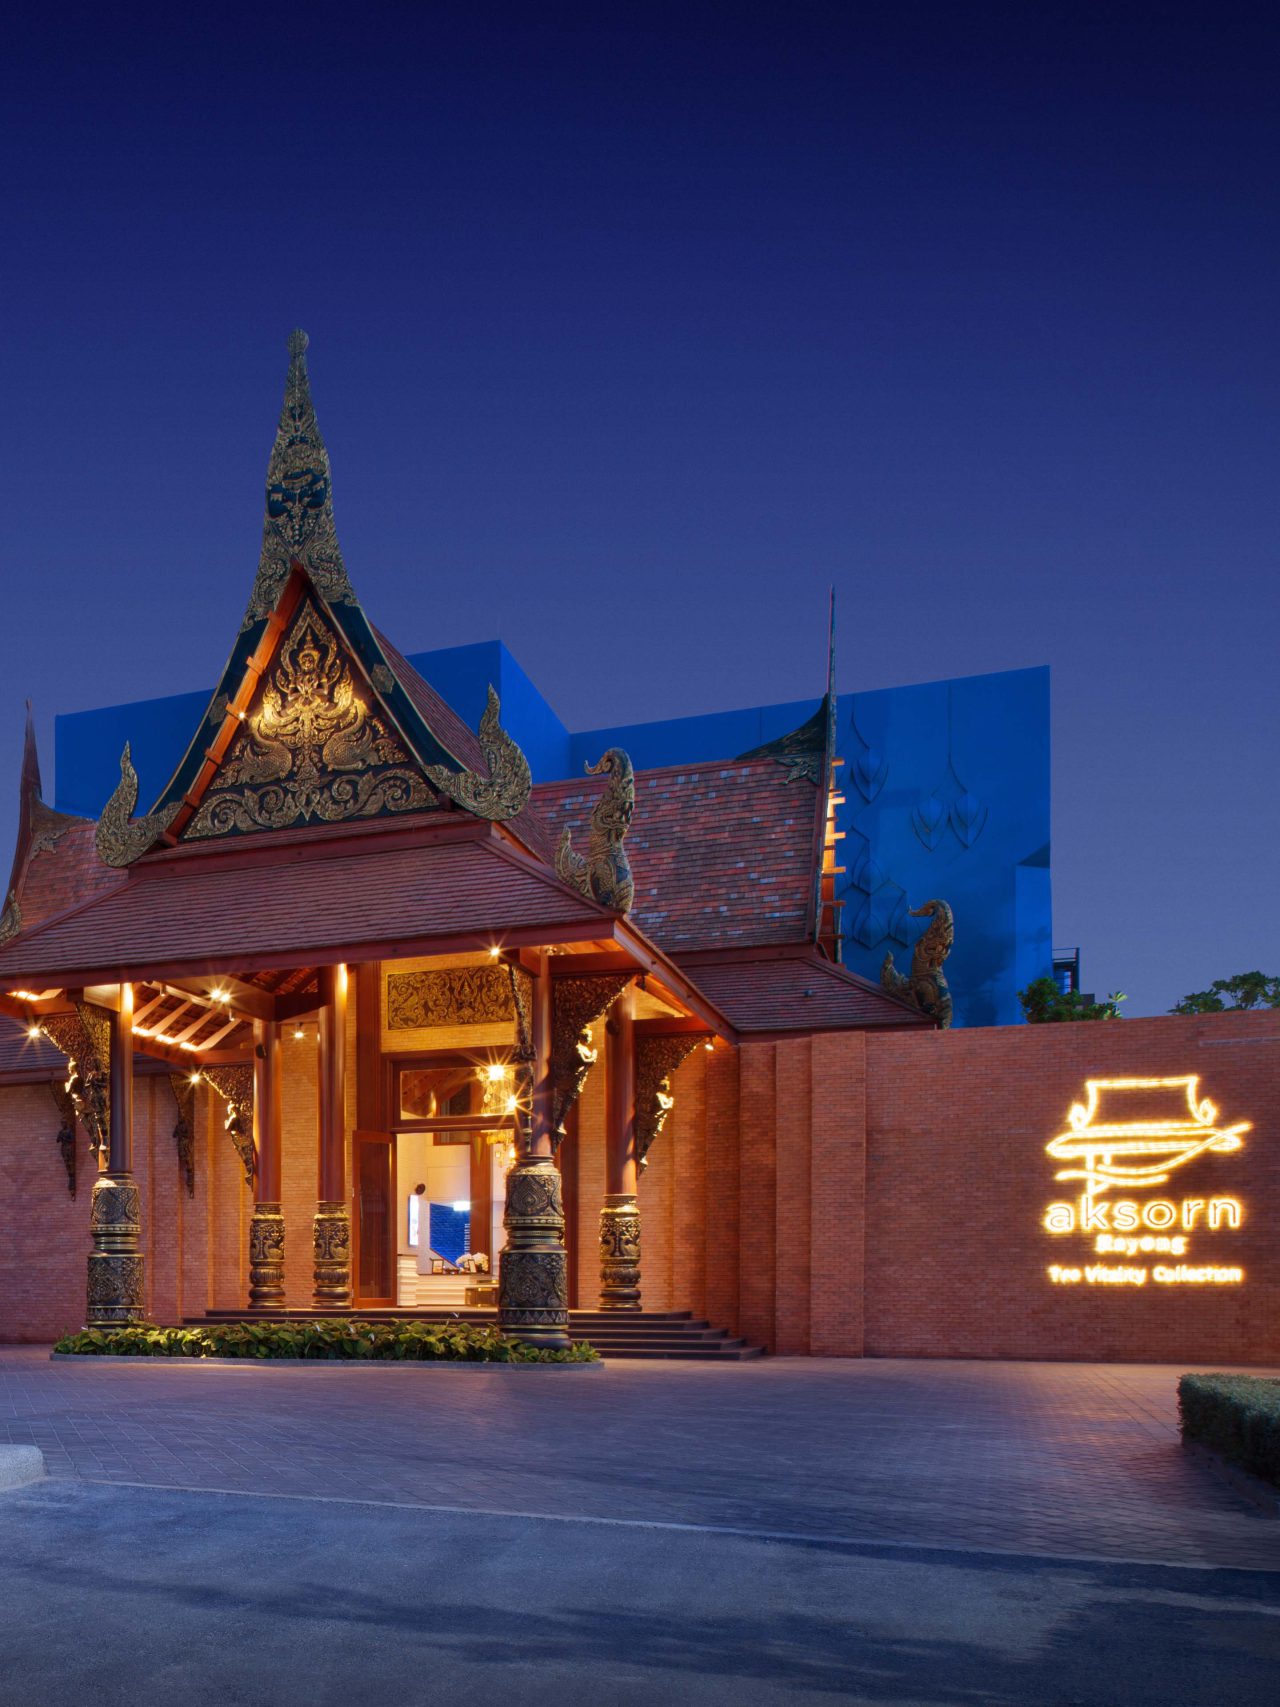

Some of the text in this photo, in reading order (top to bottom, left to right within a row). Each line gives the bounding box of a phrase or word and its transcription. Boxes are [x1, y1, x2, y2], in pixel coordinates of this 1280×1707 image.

[1045, 1195, 1242, 1232] aksorn
[1096, 1234, 1187, 1256] Rayong
[1084, 1264, 1147, 1286] Vitality
[1153, 1265, 1243, 1284] Collection
